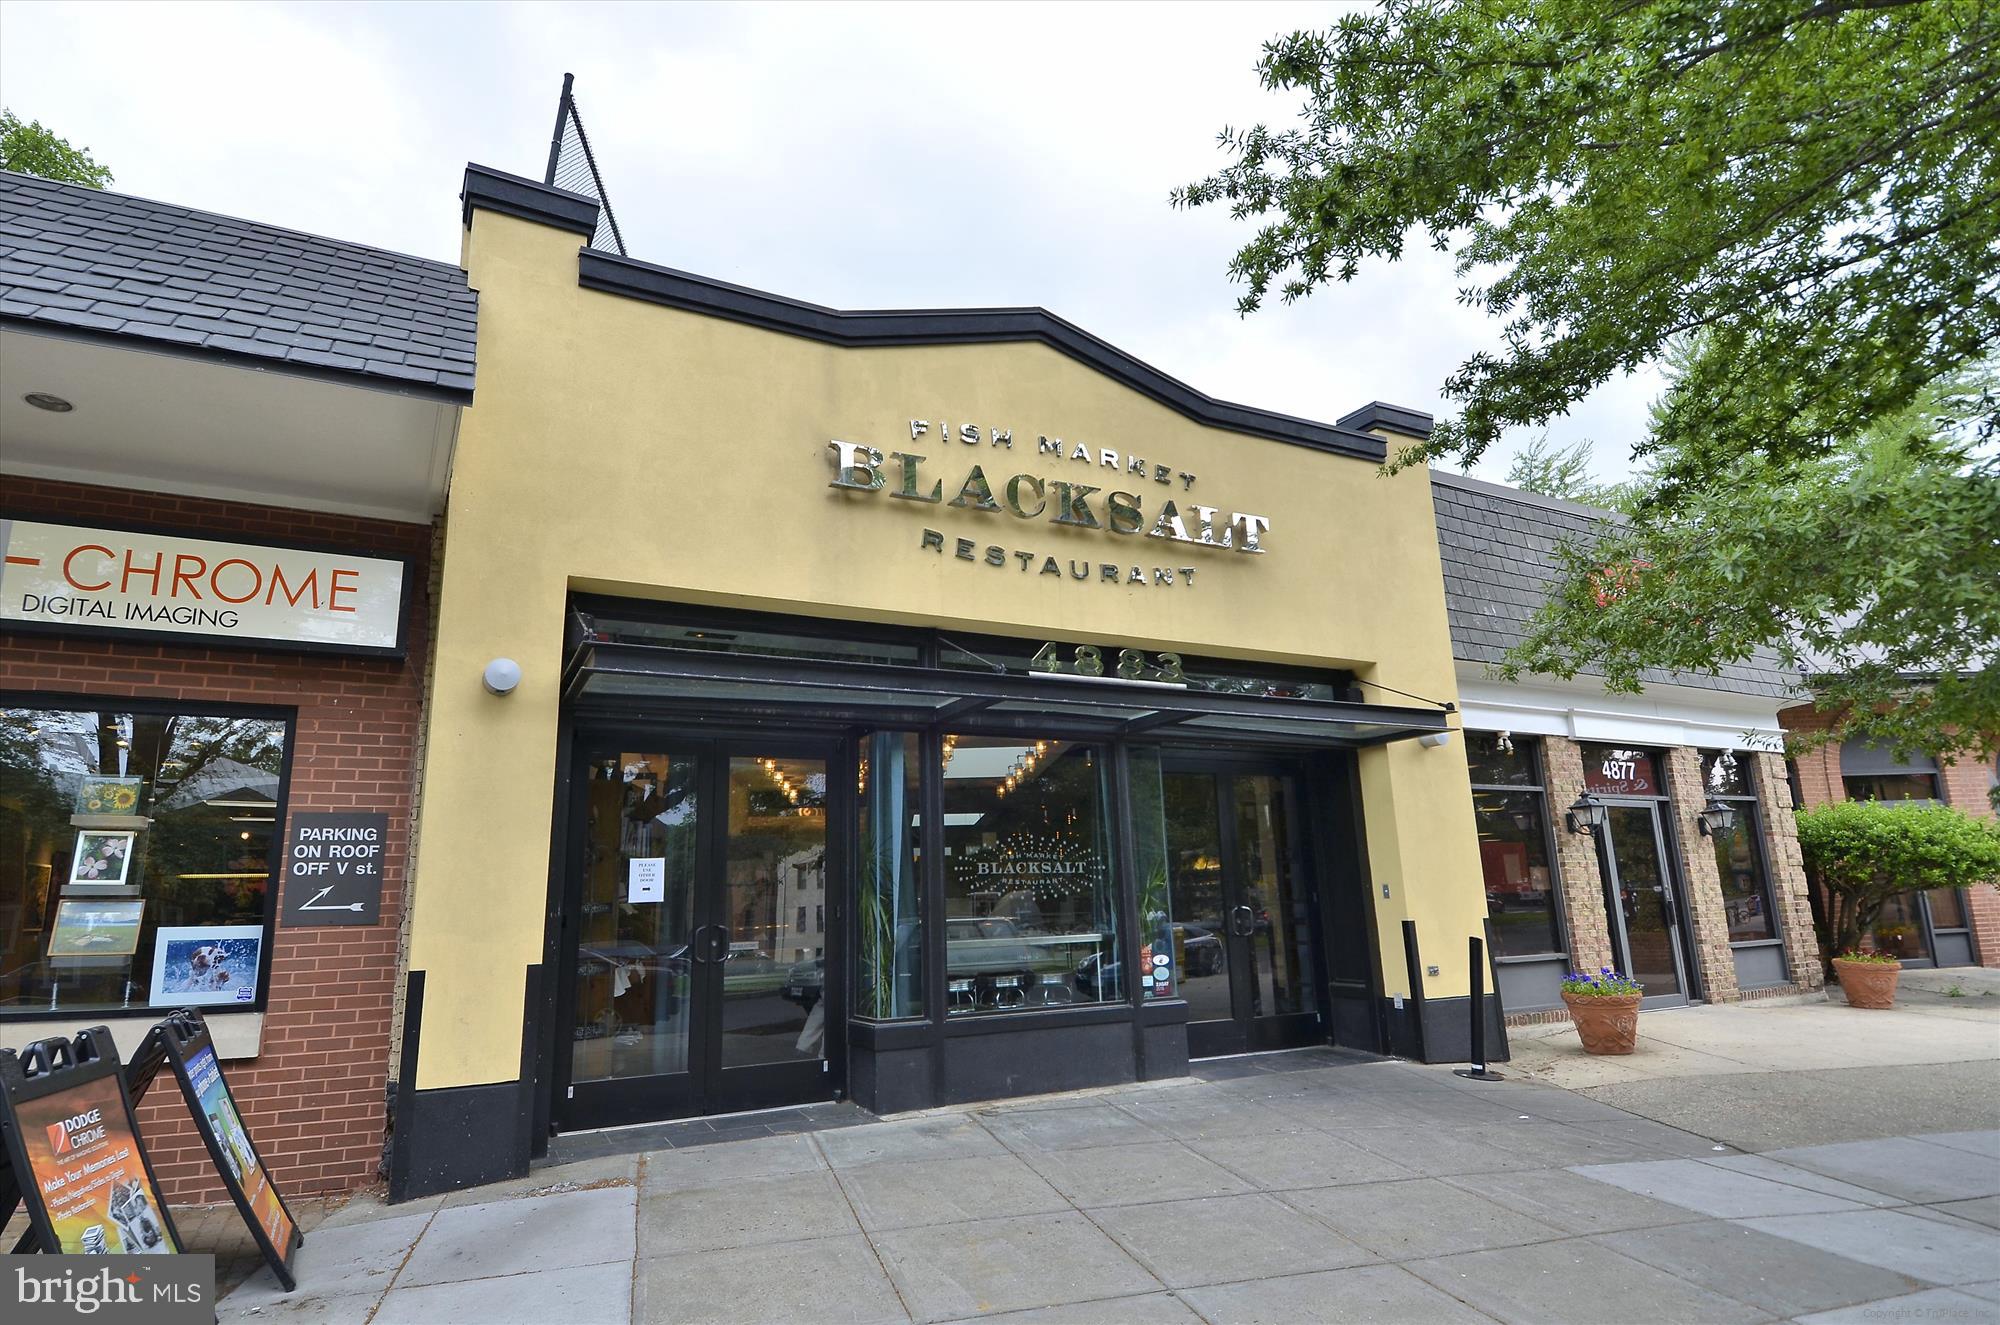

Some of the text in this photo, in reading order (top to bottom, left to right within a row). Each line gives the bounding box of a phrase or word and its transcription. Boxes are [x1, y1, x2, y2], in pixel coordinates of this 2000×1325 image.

[908, 419, 1197, 491] FISH MARKET
[828, 439, 1270, 555] BLACKSALT
[920, 528, 1198, 586] RESTAURANT
[62, 544, 360, 613] CHROME
[22, 594, 240, 629] DIGITAL IMAGING
[1031, 641, 1184, 682] 4883
[1602, 760, 1636, 780] 4877
[299, 827, 378, 841] PARKING
[293, 844, 381, 858] ON ROOF
[1000, 850, 1065, 862] FISH MARKET
[292, 861, 378, 876] OFF V st.
[976, 861, 1088, 875] BLACKSALT
[1002, 876, 1064, 886] RESTAURANT
[65, 1109, 102, 1133] DODGE
[70, 1125, 106, 1149] CHROME
[44, 1148, 129, 1193] Make Your Memories Last
